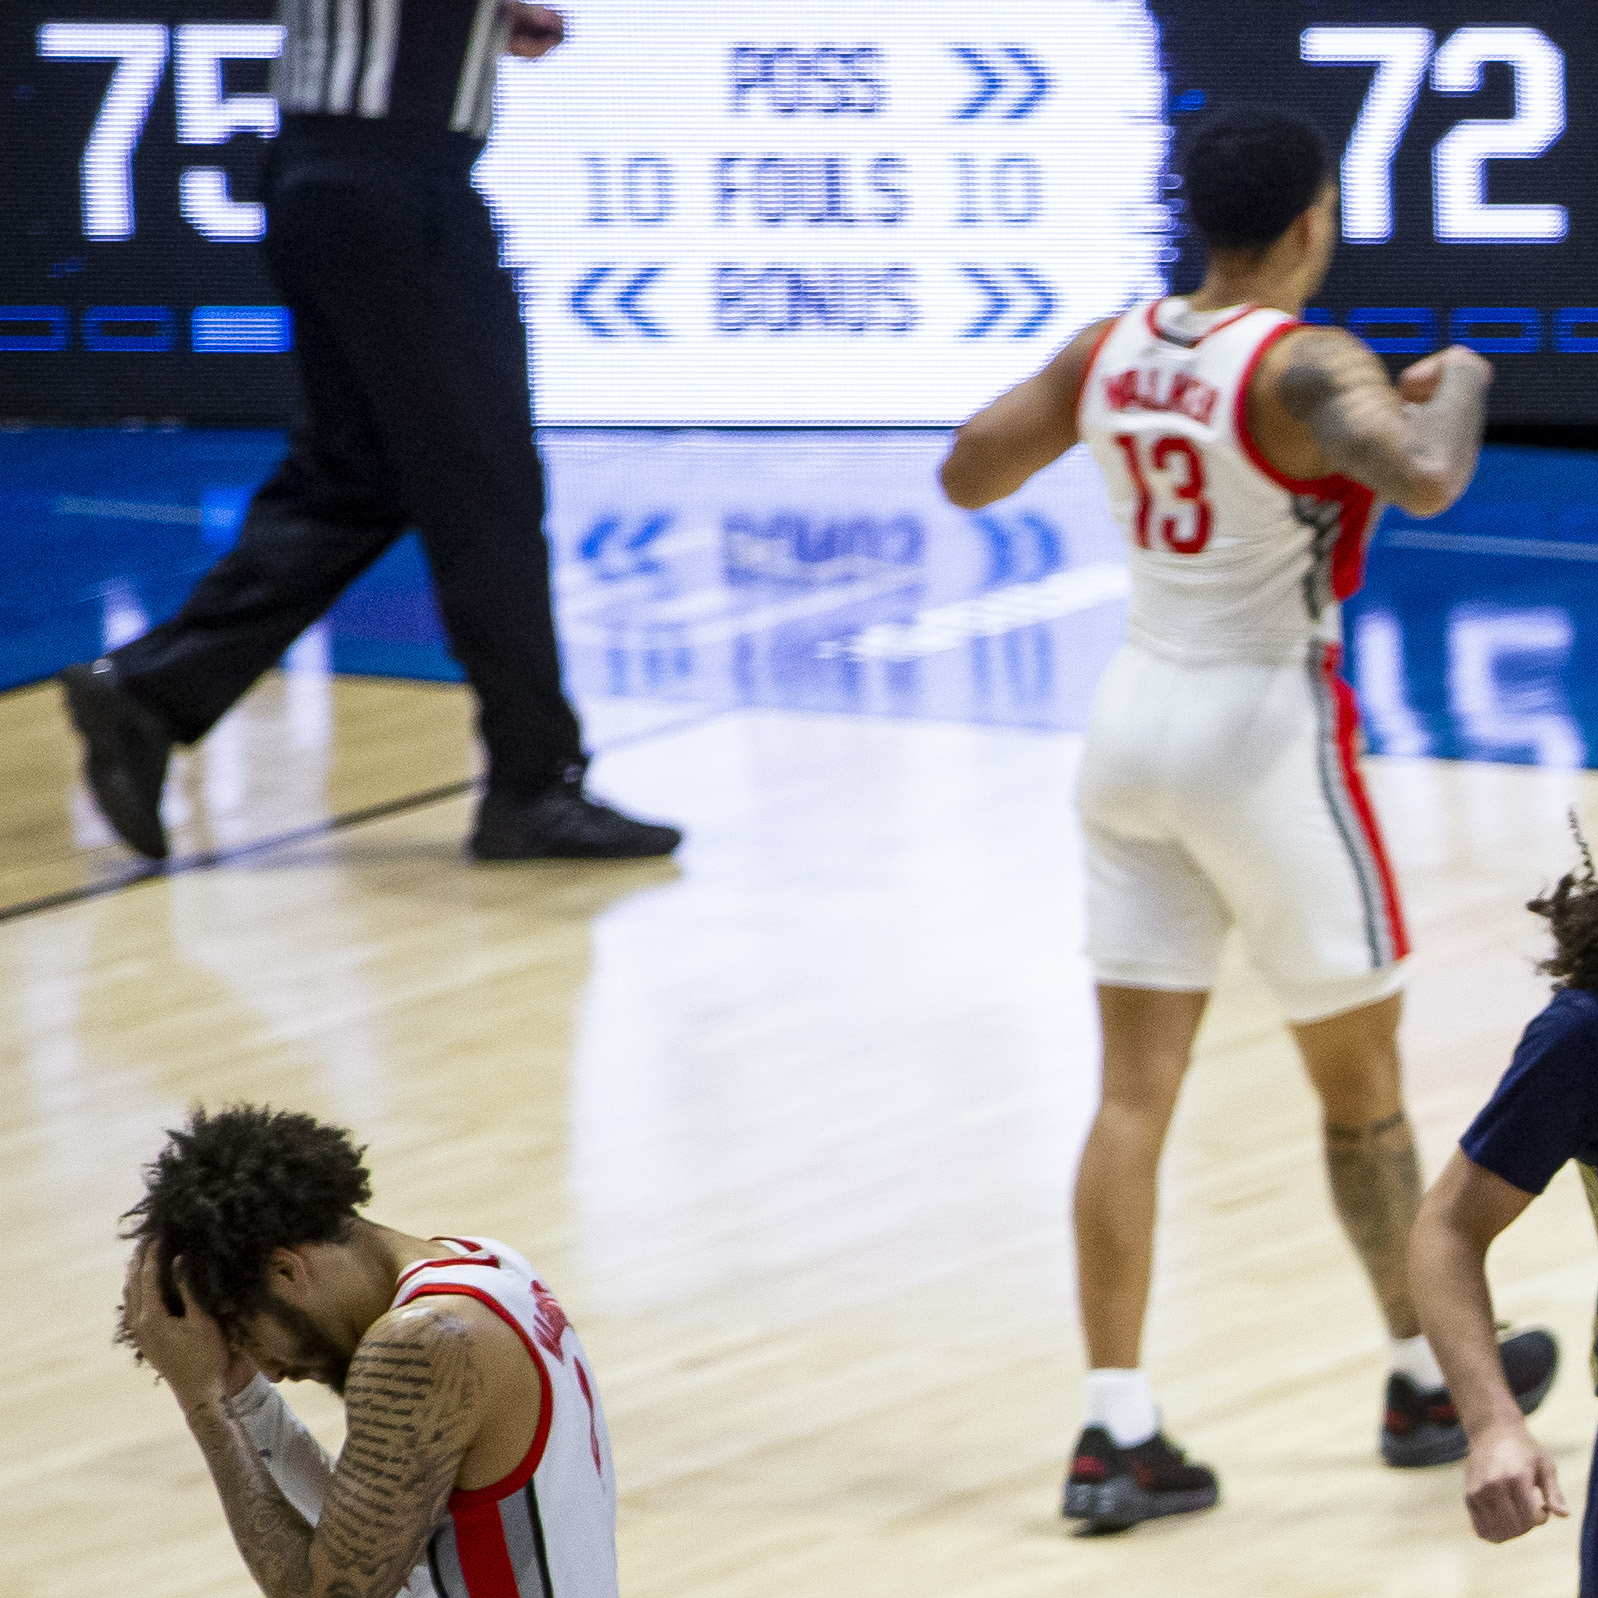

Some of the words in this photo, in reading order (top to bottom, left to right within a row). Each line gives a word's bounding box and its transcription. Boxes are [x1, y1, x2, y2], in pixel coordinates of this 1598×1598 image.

[730, 43, 888, 117] POSS
[35, 23, 287, 243] 75
[1299, 26, 1568, 244] 72
[586, 153, 674, 226] 10
[713, 153, 912, 226] FOULS
[951, 153, 1045, 226] 10
[713, 263, 917, 338] BONUS
[1114, 434, 1213, 555] 13
